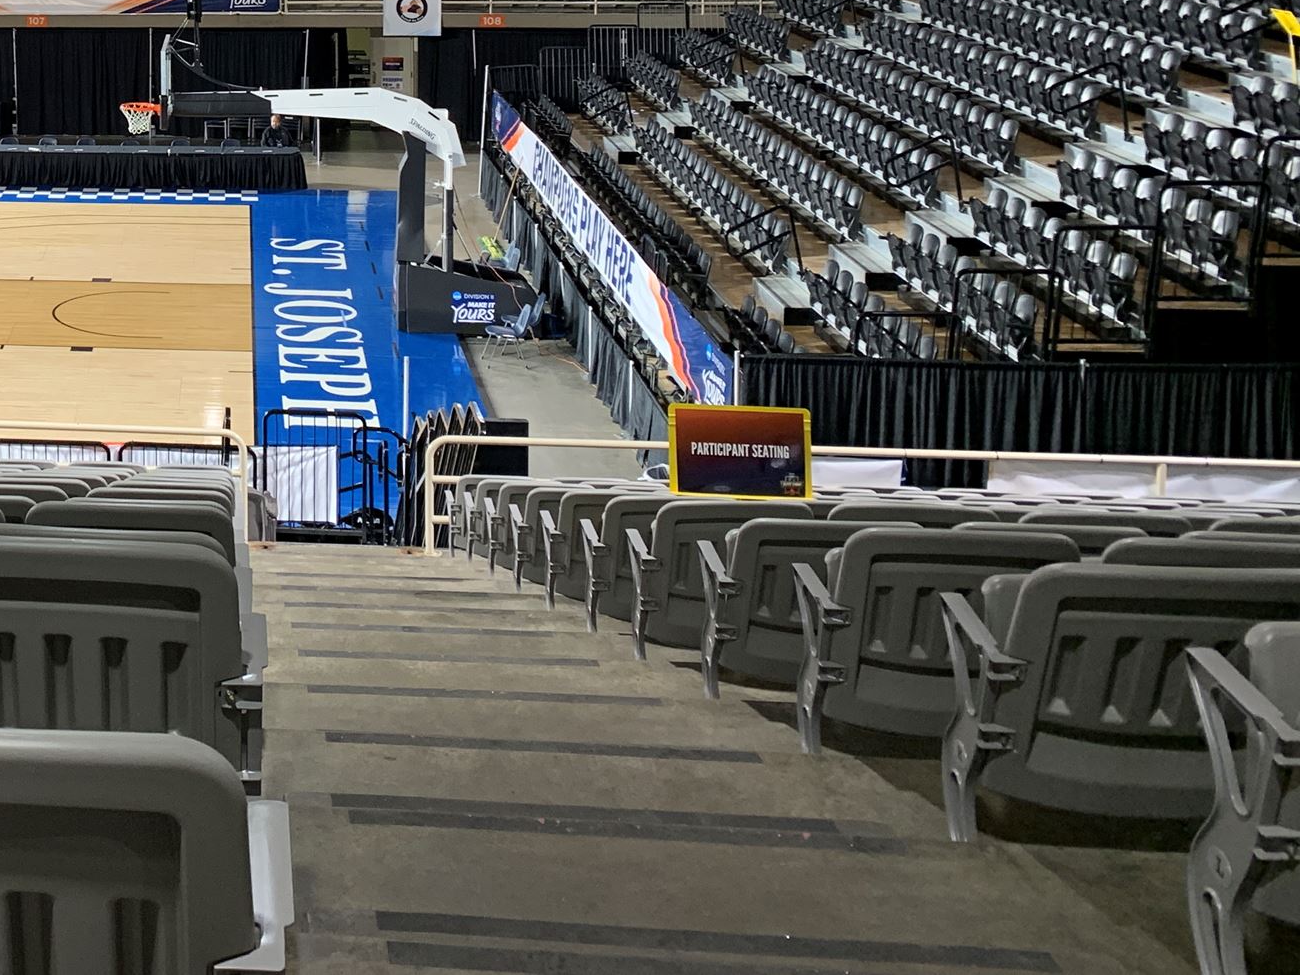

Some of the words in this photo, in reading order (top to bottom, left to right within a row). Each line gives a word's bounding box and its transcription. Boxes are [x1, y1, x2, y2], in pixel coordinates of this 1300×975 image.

[28, 16, 45, 25] 107
[483, 17, 502, 25] 108
[532, 140, 580, 235] CHAMPIONS
[579, 196, 607, 265] PLAY
[604, 227, 636, 306] HERE
[269, 237, 348, 275] ST.
[451, 304, 495, 323] YOURS
[691, 441, 749, 458] PARTICIPANT
[751, 444, 790, 459] SEATING
